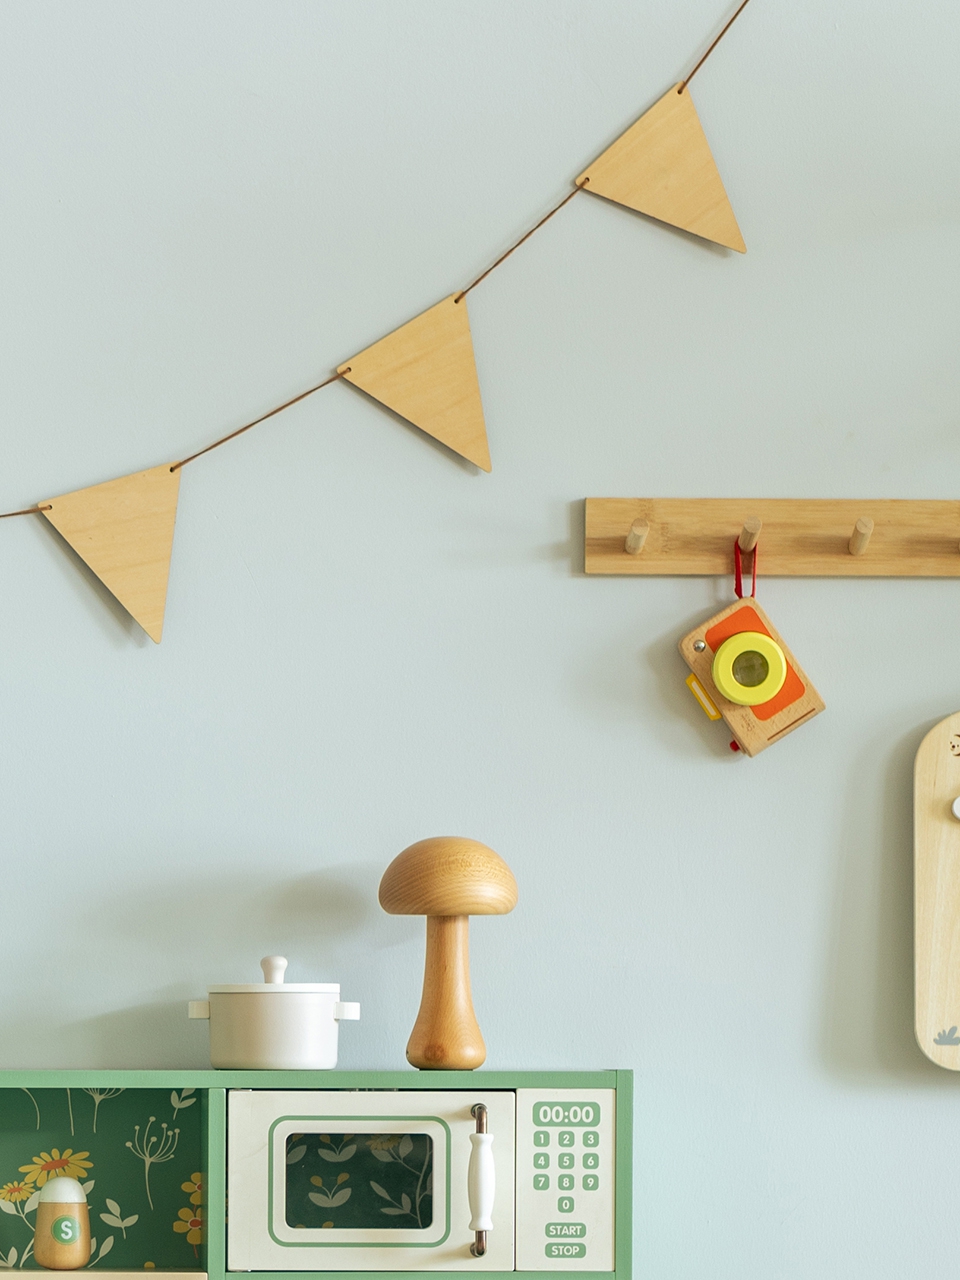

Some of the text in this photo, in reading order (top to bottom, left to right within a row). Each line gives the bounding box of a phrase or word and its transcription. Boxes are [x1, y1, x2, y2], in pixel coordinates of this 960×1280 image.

[539, 1105, 594, 1123] 00:00
[539, 1134, 594, 1144] 1 2 3
[538, 1156, 594, 1166] 4 5 6
[538, 1177, 594, 1188] 7 8 9
[562, 1199, 570, 1210] 0
[60, 1220, 73, 1240] S
[549, 1225, 582, 1236] START
[551, 1246, 580, 1256] STOP
